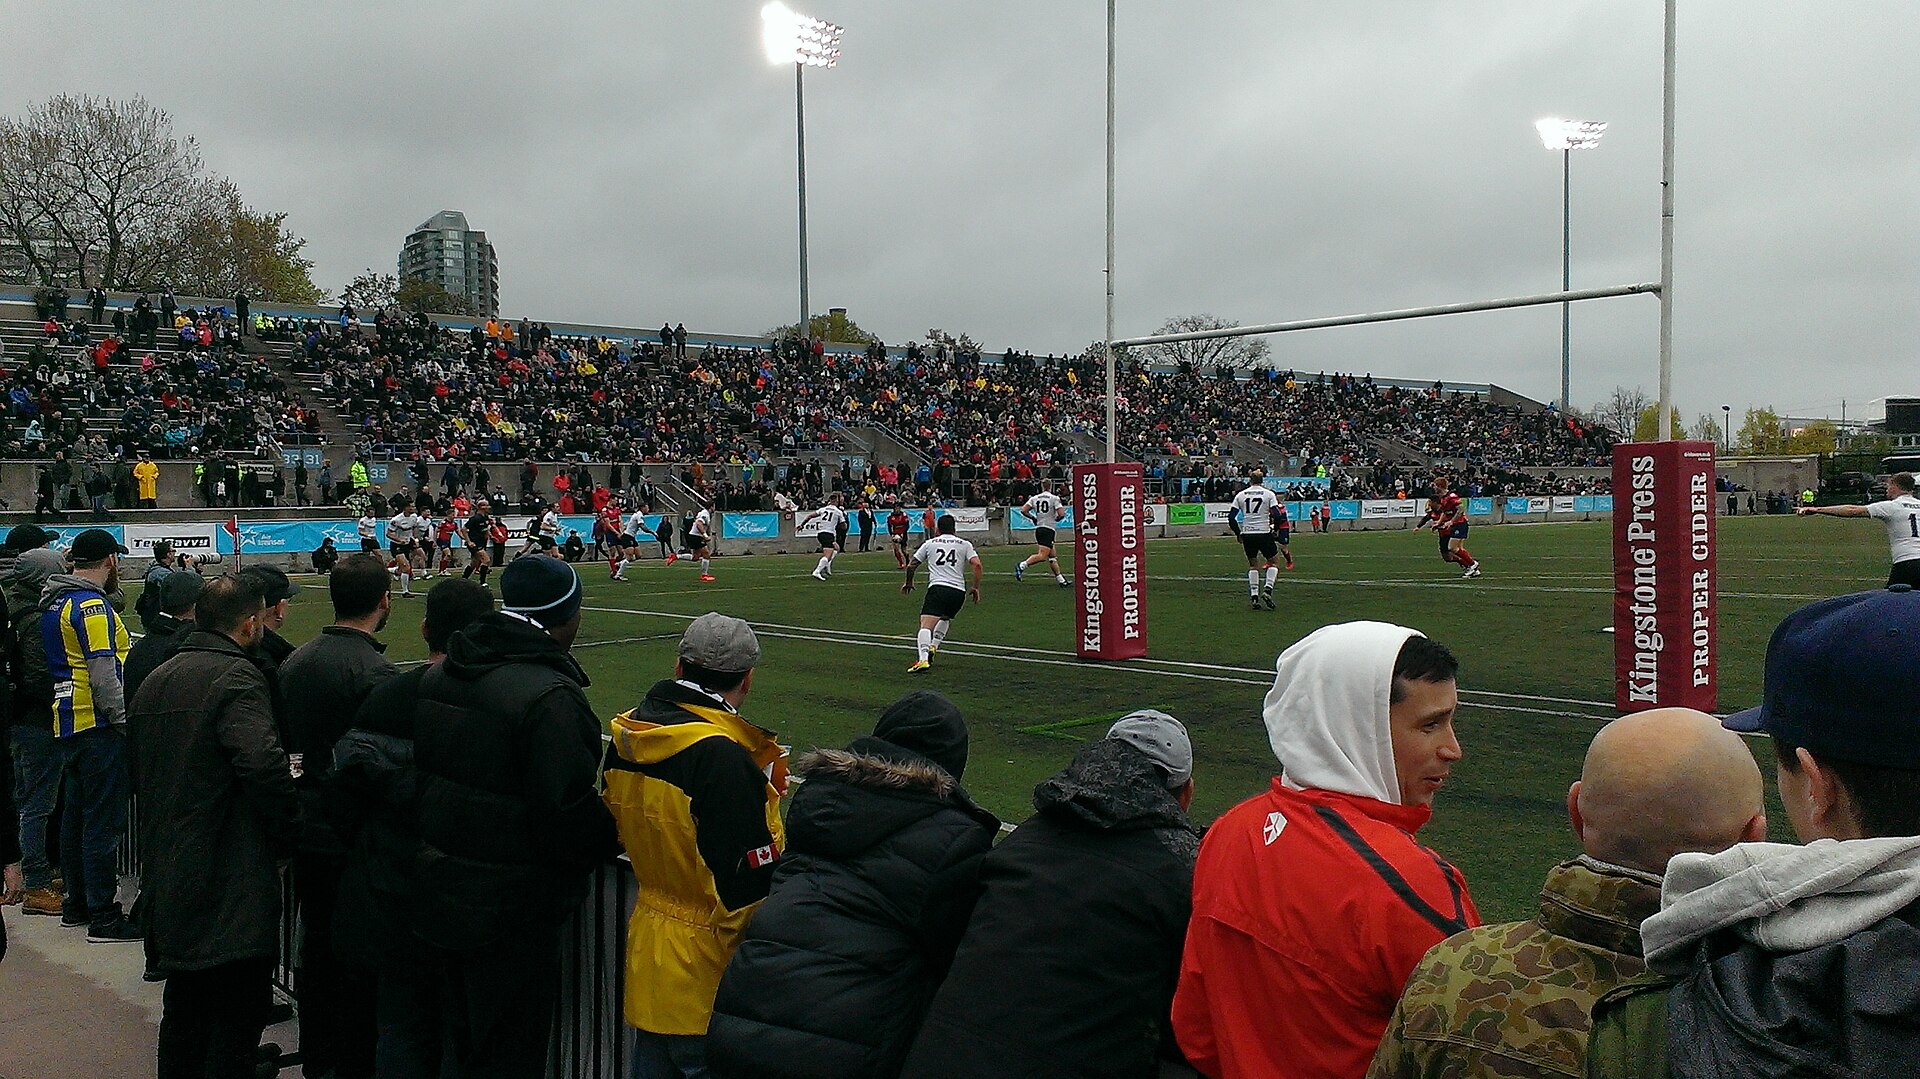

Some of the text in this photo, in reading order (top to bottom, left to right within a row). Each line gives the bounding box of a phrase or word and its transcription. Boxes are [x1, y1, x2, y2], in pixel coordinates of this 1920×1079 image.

[369, 468, 388, 479] 33
[1244, 497, 1263, 514] 17
[822, 510, 834, 522] 21
[1035, 500, 1050, 514] 10
[1120, 485, 1137, 550] CIDER
[1691, 471, 1709, 561] CIDER
[935, 548, 958, 567] 24
[1081, 473, 1103, 653] Kingstone Press
[1628, 455, 1664, 704] Kingstone Press
[1122, 554, 1139, 640] PROPER
[1692, 568, 1710, 688] PROPER
